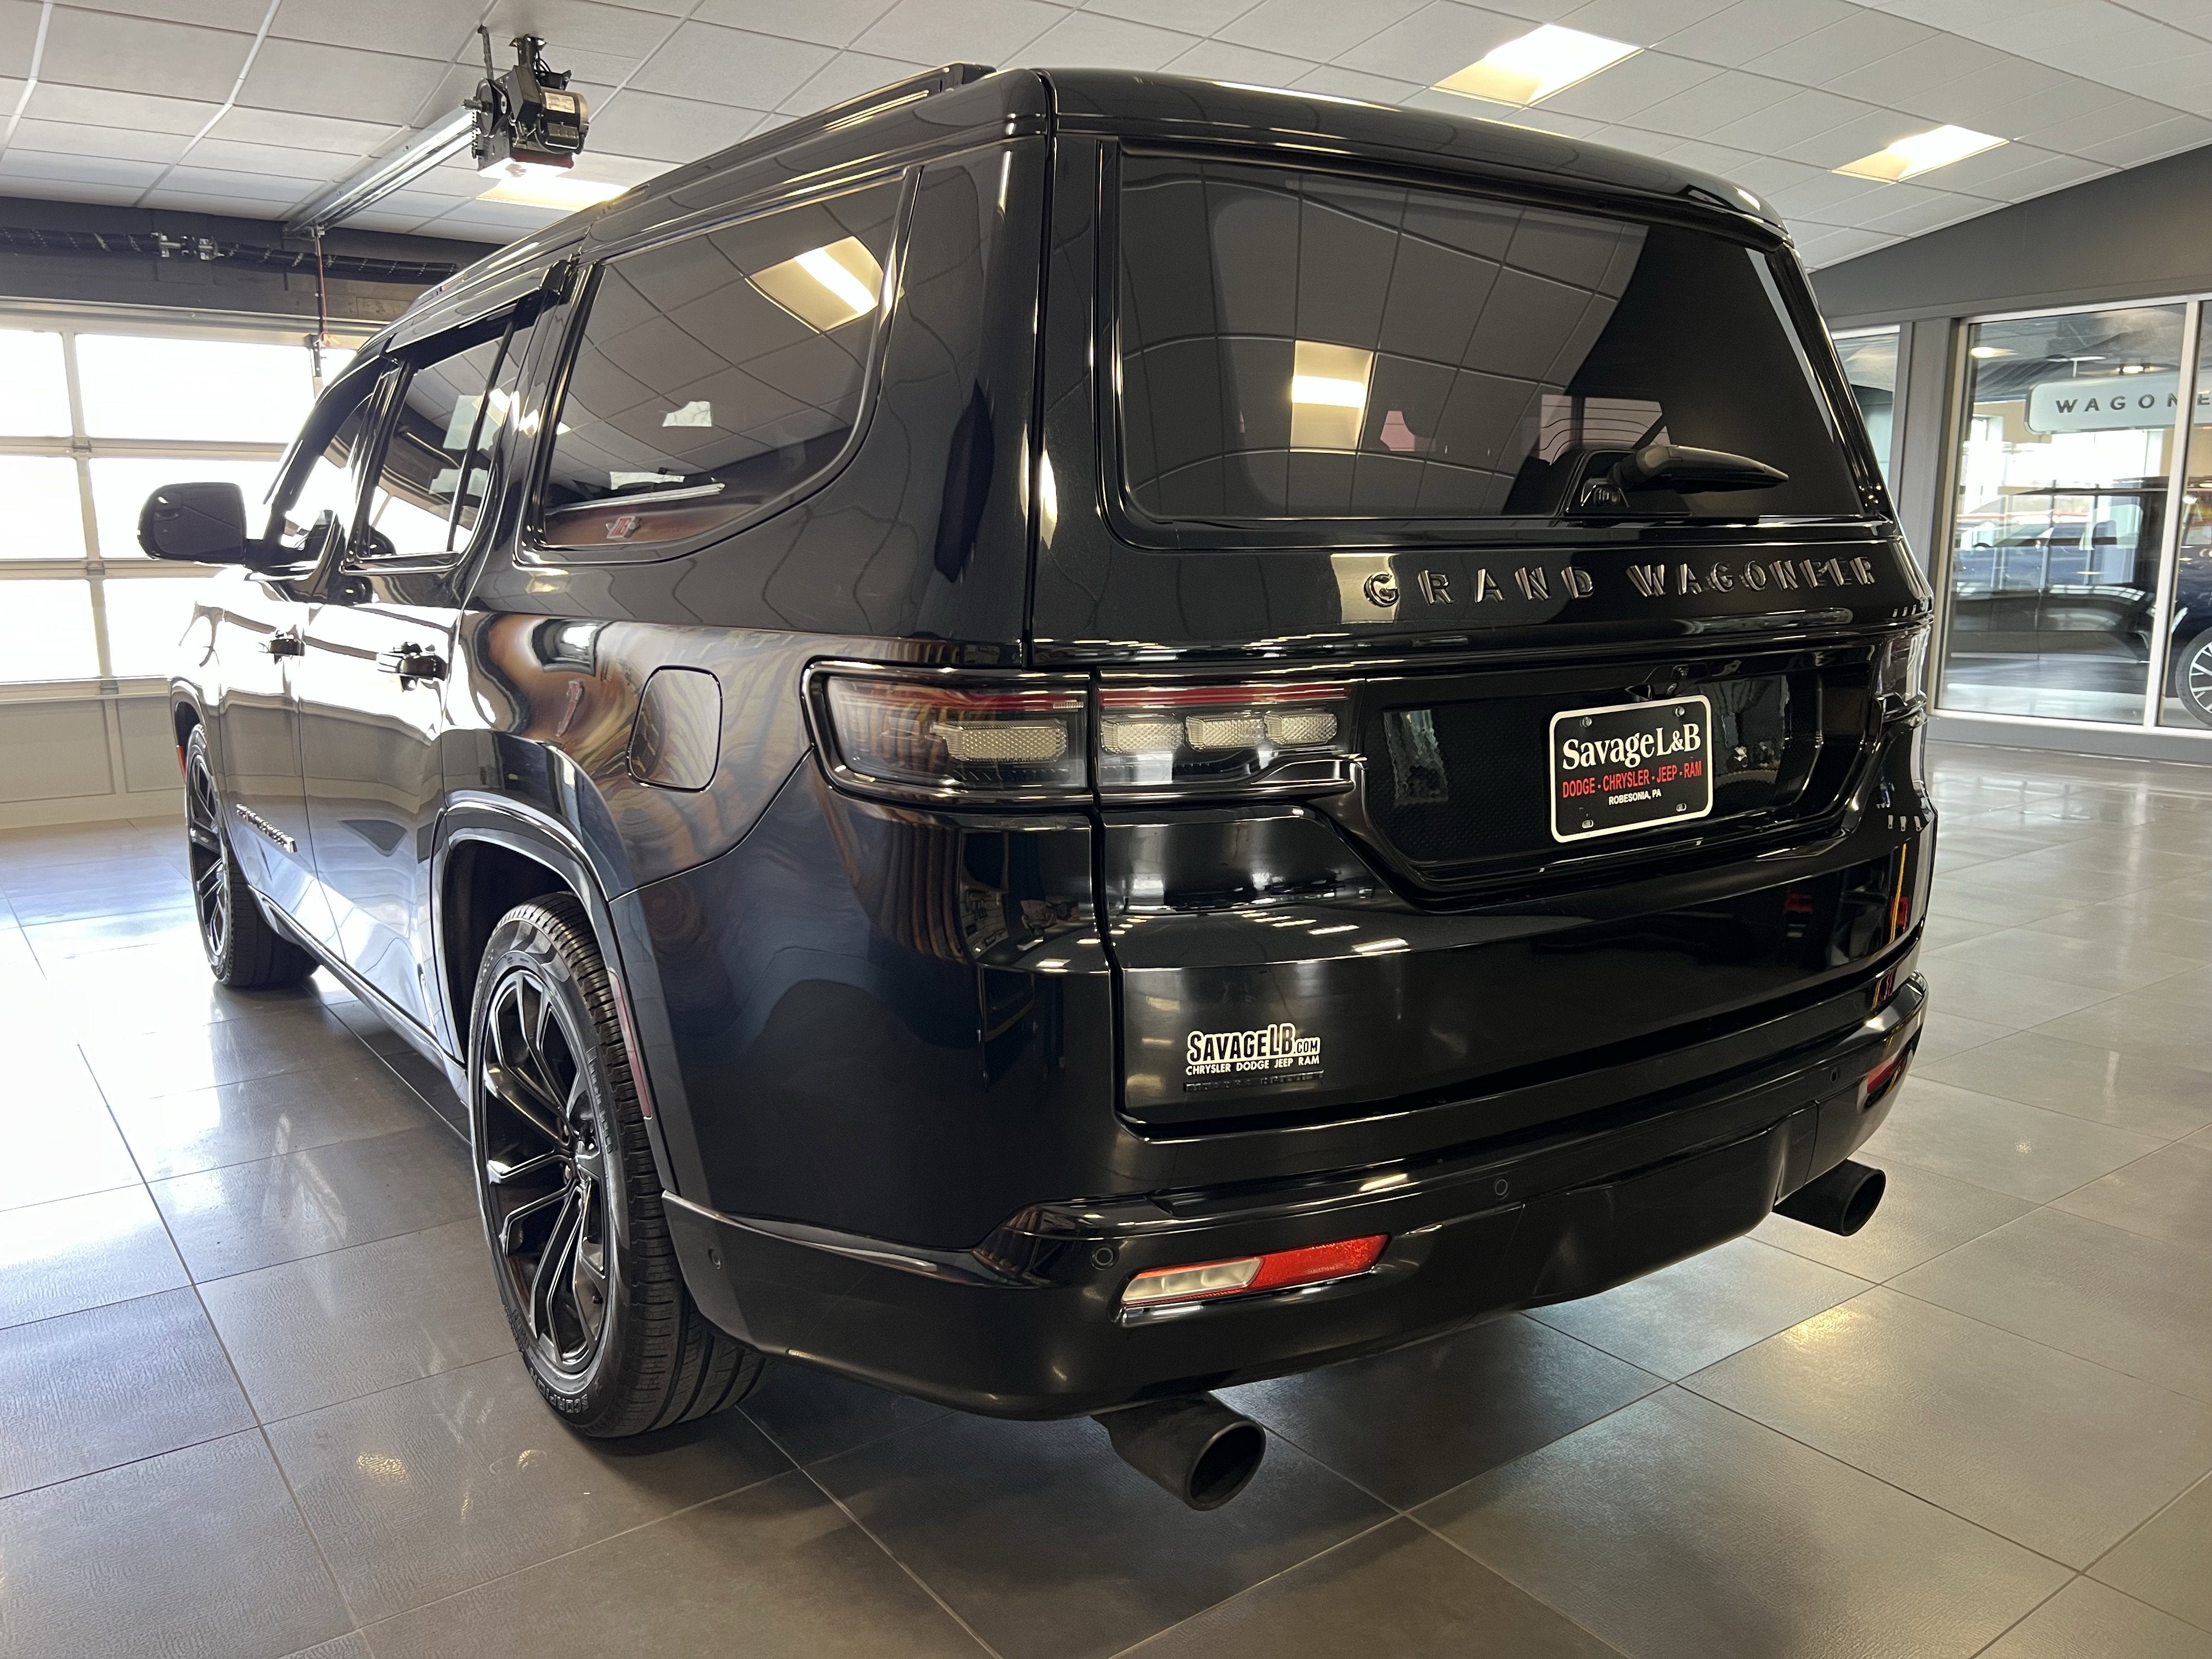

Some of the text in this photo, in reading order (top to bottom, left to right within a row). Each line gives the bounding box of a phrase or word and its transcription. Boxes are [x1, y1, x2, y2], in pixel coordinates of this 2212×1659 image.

[1363, 566, 1594, 607] GRAND
[1562, 760, 1702, 798] DODGE CHRYSLER JEEP RAM
[1609, 788, 1662, 805] ROBESONIA, PA
[1186, 1054, 1319, 1076] CHRYSLER DODGE JEEP RAM
